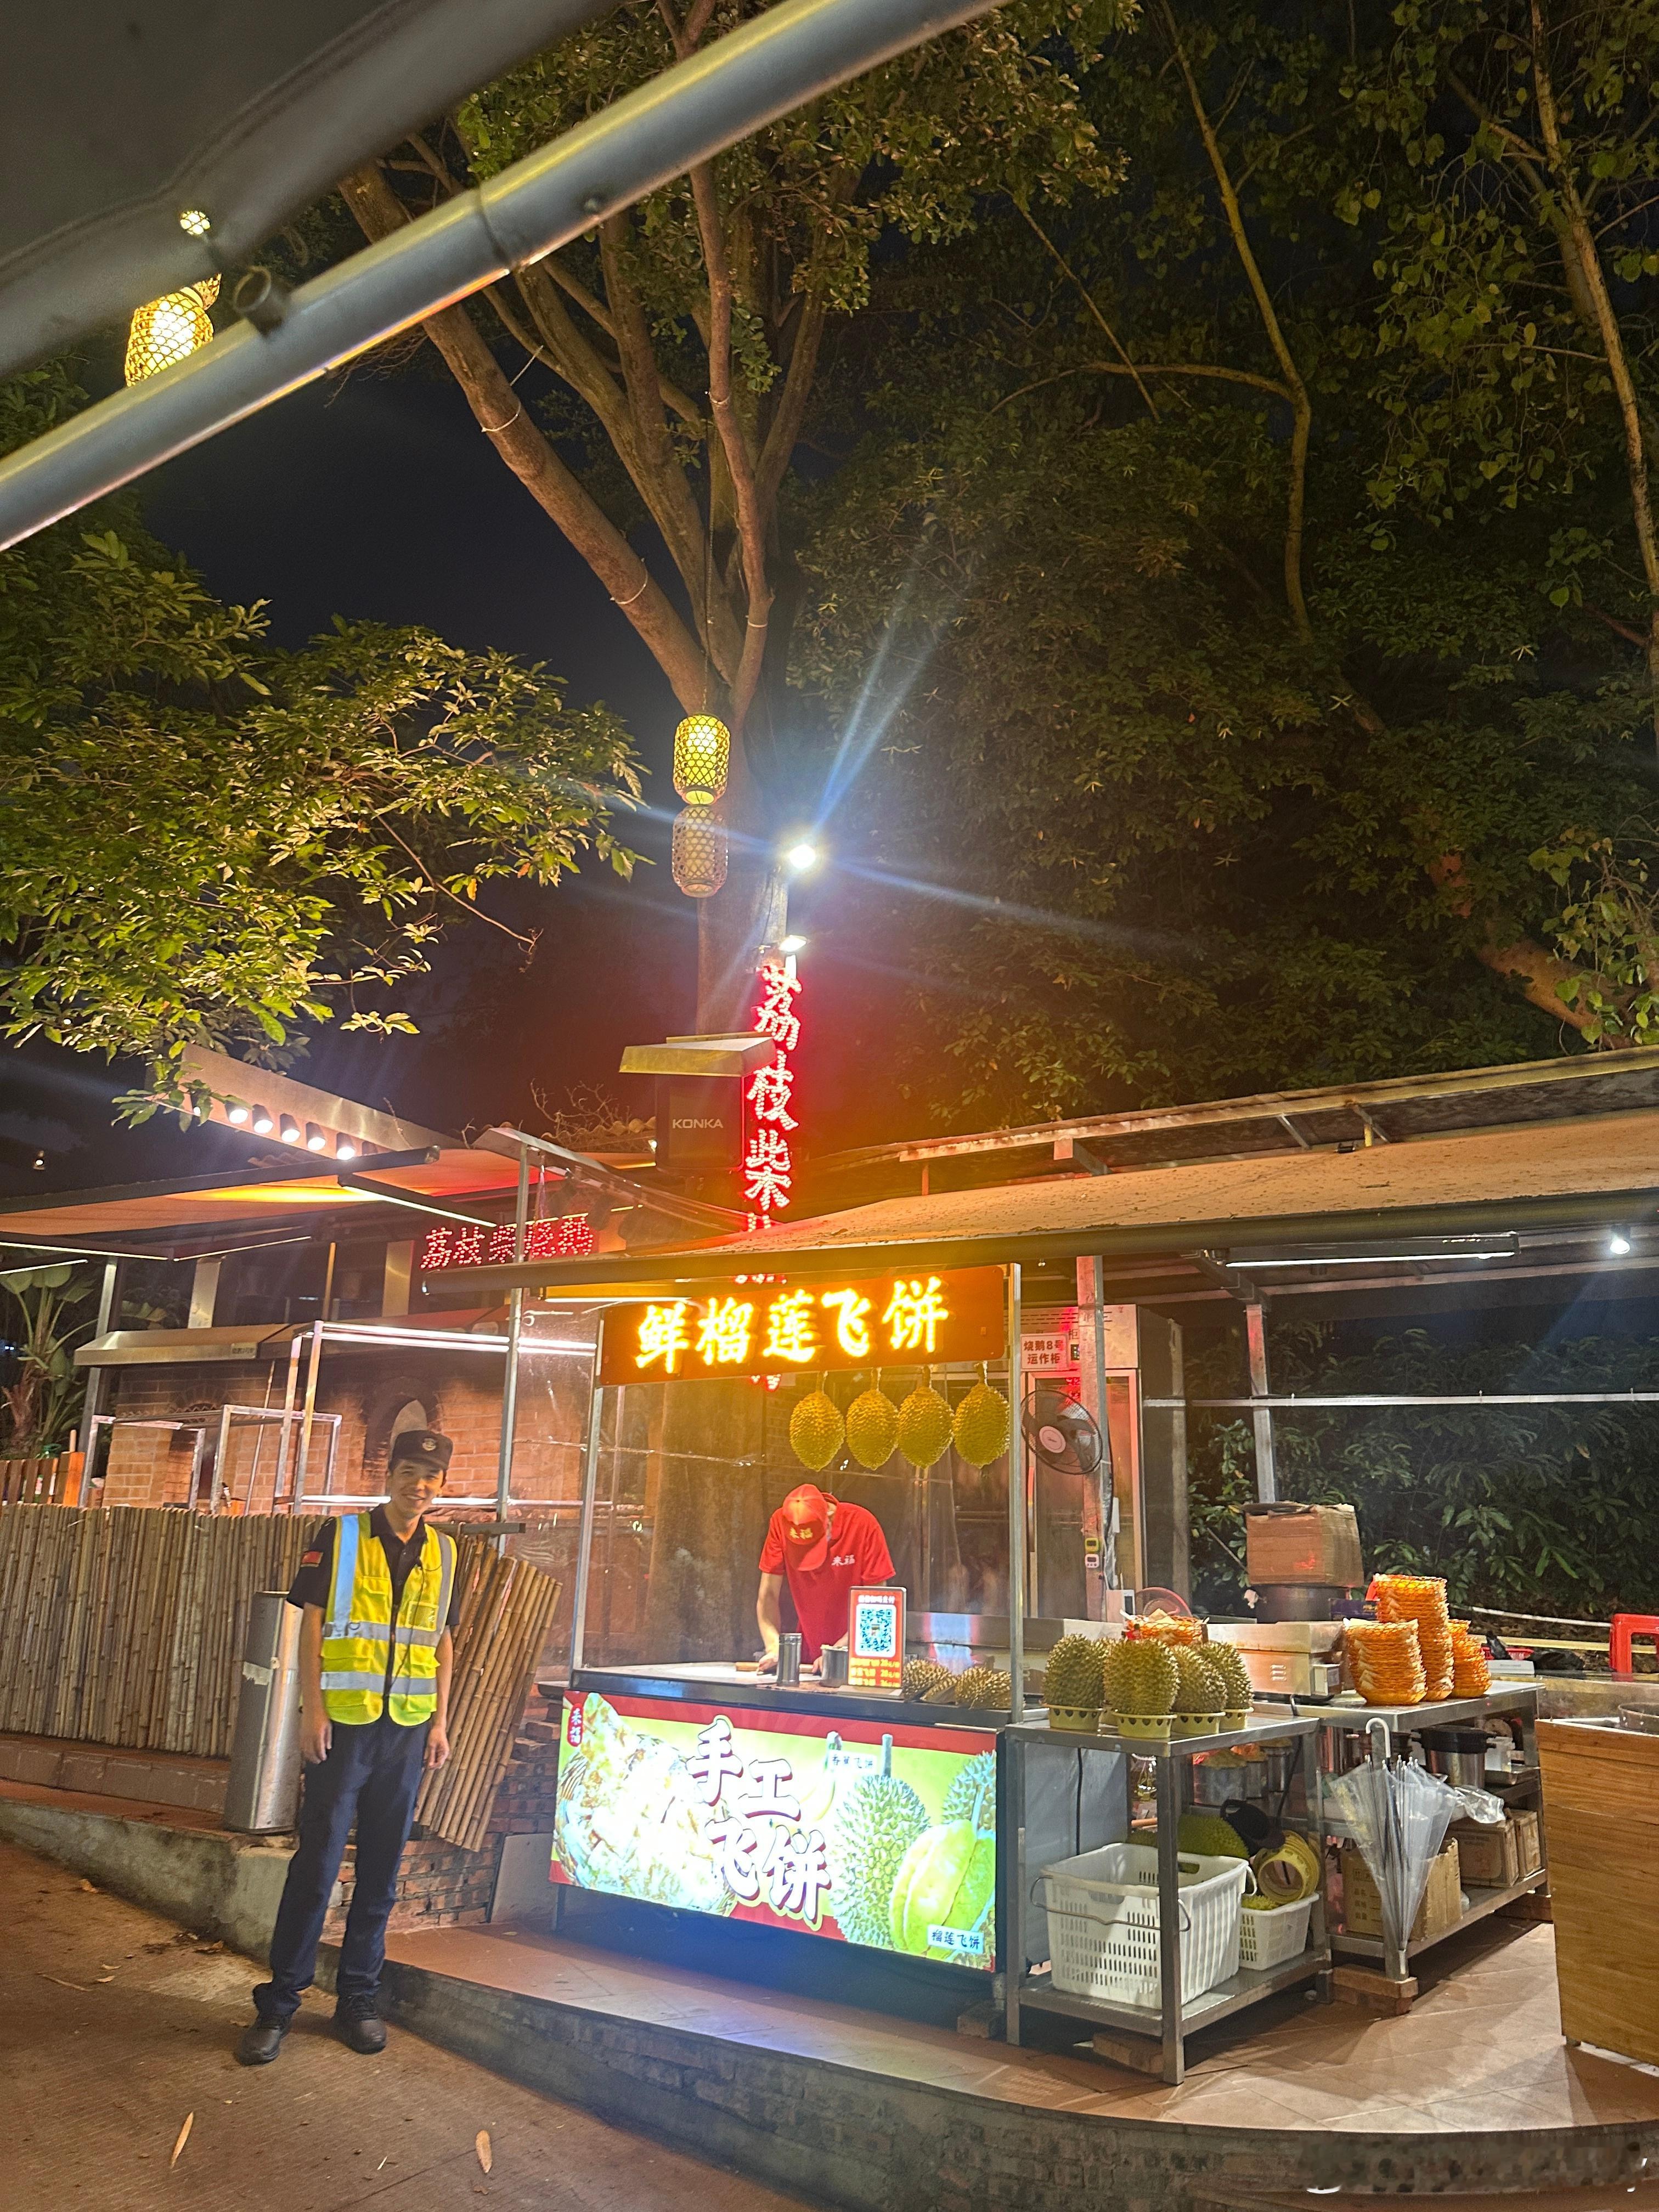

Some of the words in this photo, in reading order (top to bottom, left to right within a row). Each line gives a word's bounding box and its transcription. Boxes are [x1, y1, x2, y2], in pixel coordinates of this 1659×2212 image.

[745, 964, 803, 1234] 荔枝柴
[672, 1118, 724, 1130] KONKA
[635, 1275, 950, 1374] 鲜榴莲飞饼
[1024, 1340, 1064, 1352] 烧鹅8号
[1027, 1352, 1062, 1365] 运作柜
[831, 1555, 855, 1567] 来福
[686, 1716, 803, 1824] 手工
[706, 1816, 833, 1927] 飞饼
[932, 1929, 980, 1950] 榴莲飞饼
